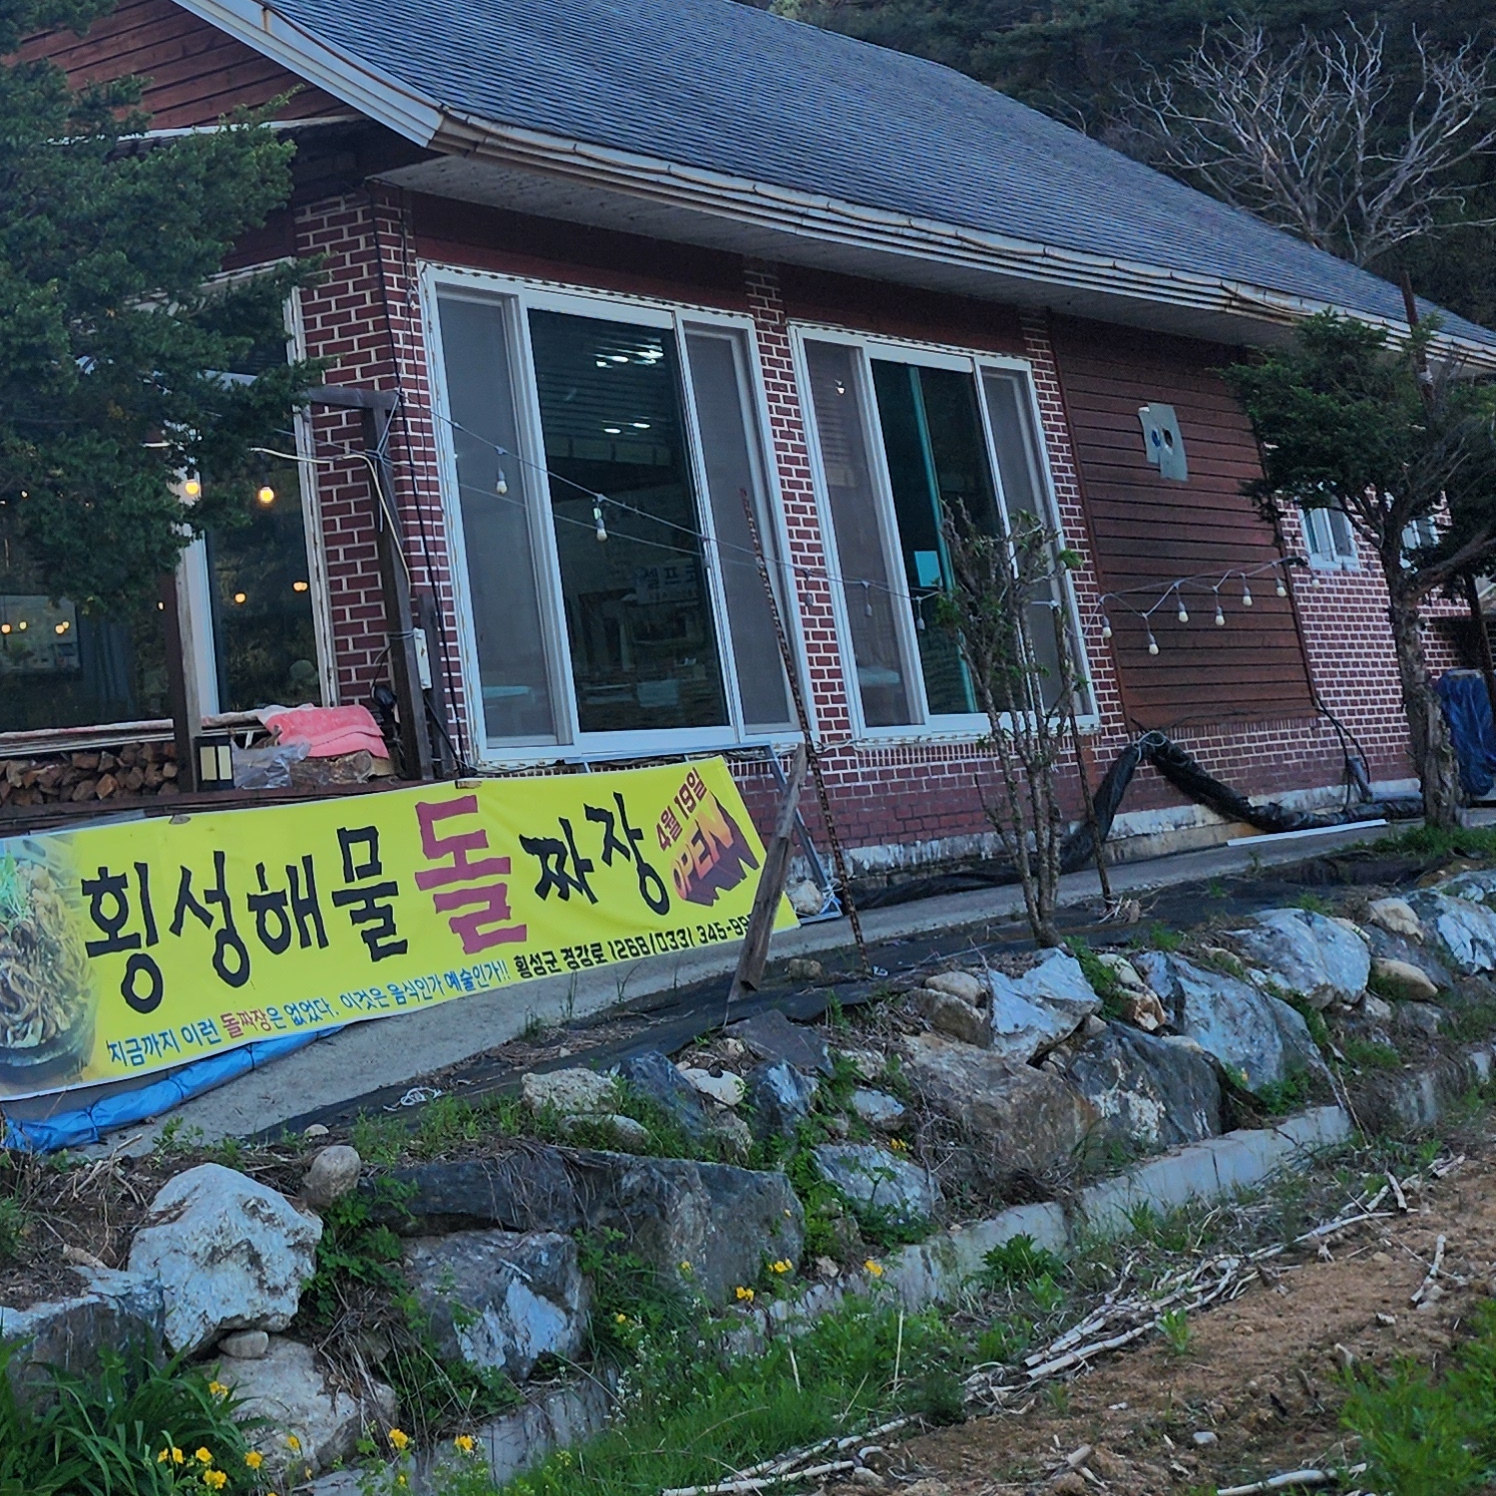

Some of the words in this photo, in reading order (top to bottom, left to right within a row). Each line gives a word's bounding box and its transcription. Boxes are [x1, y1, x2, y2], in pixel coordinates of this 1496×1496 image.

[656, 805, 683, 852] 4월
[673, 767, 708, 820] 19일
[669, 790, 736, 901] OPEN
[106, 1029, 181, 1067] 지금까지
[181, 1019, 222, 1045] 이런
[220, 1006, 287, 1039] 돌짜장은
[340, 987, 390, 1010] 이것은
[386, 973, 446, 1006] 음식인가
[513, 950, 562, 979] 횡성군
[696, 914, 753, 944] 345-99
